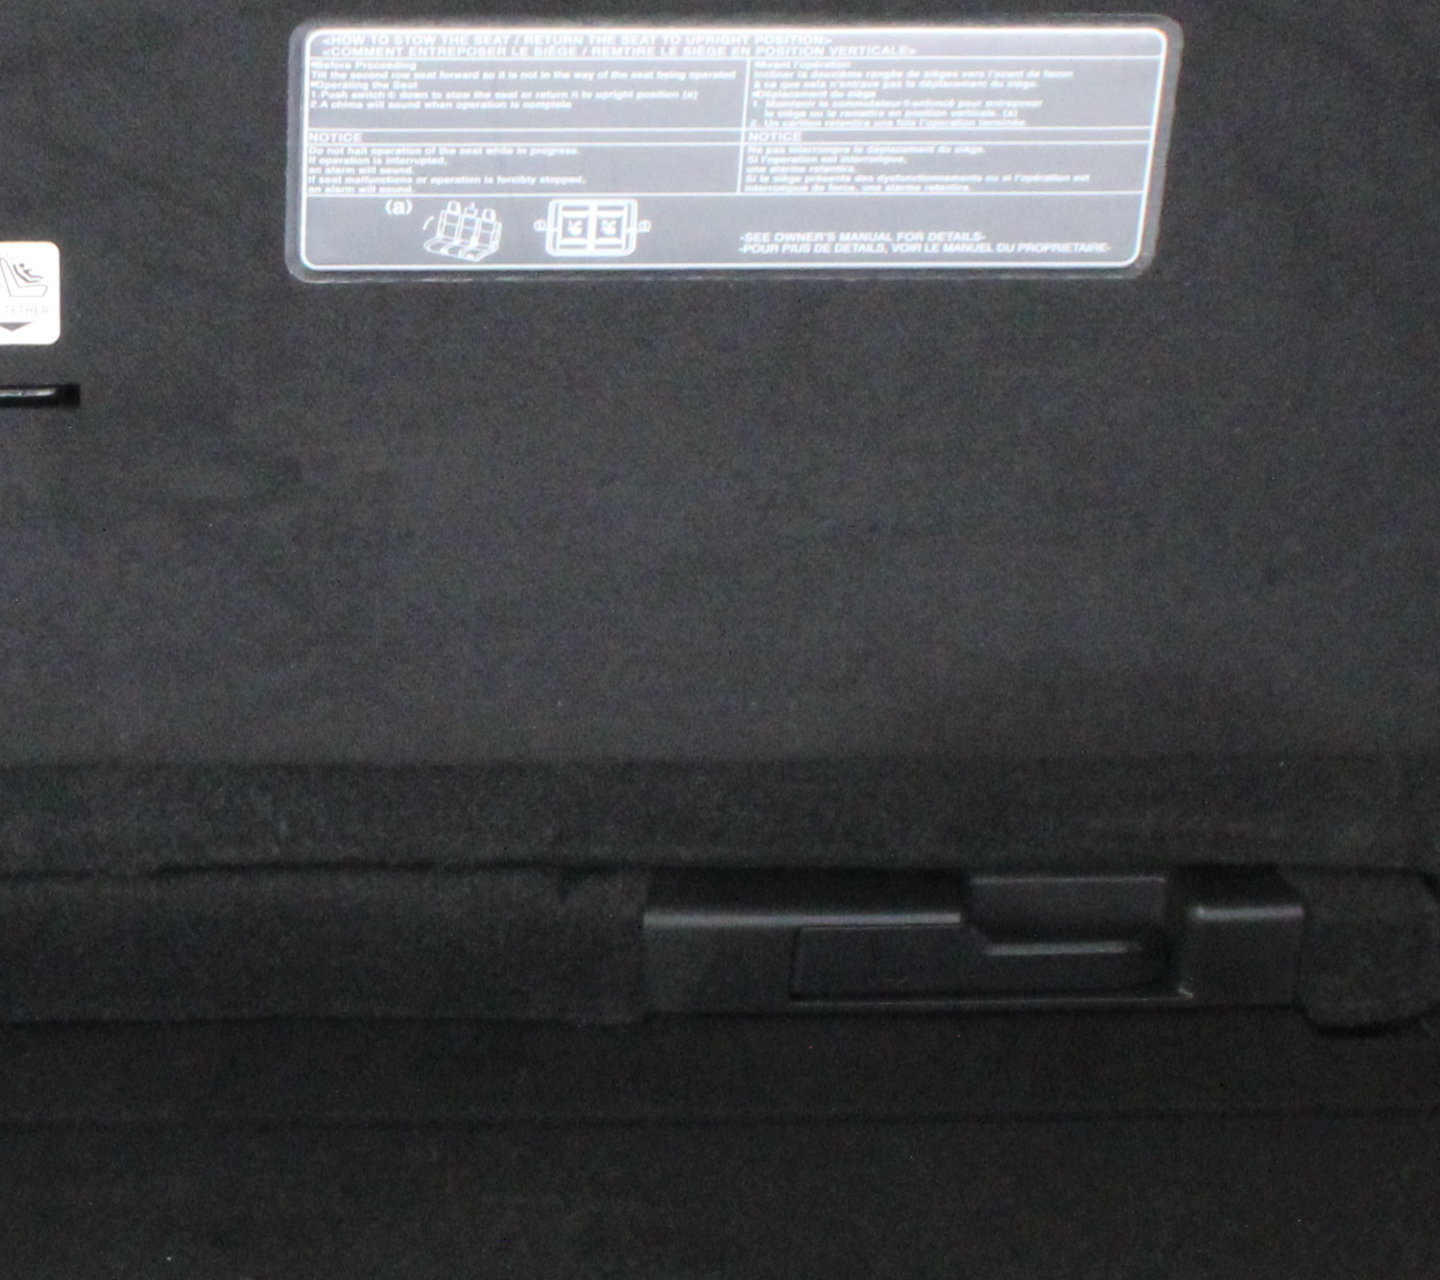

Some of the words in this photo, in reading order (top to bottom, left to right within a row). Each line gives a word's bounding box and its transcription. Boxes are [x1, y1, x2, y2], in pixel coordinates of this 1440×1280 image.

[371, 35, 389, 45] TO
[394, 35, 437, 45] STOW
[442, 35, 468, 45] THE
[474, 35, 508, 45] SEAT
[524, 35, 583, 45] RETURN
[591, 35, 617, 45] THE
[621, 35, 657, 45] SEAT
[663, 35, 681, 45] TO
[686, 35, 749, 45] UPRIGHT
[309, 132, 363, 142] NOTICE
[748, 132, 802, 142] NOTICE
[384, 199, 413, 216] (a)
[774, 232, 835, 242] OWNER'S
[838, 232, 893, 242] MANUAL
[896, 232, 924, 242] FOR
[4, 305, 49, 316] TETHER
